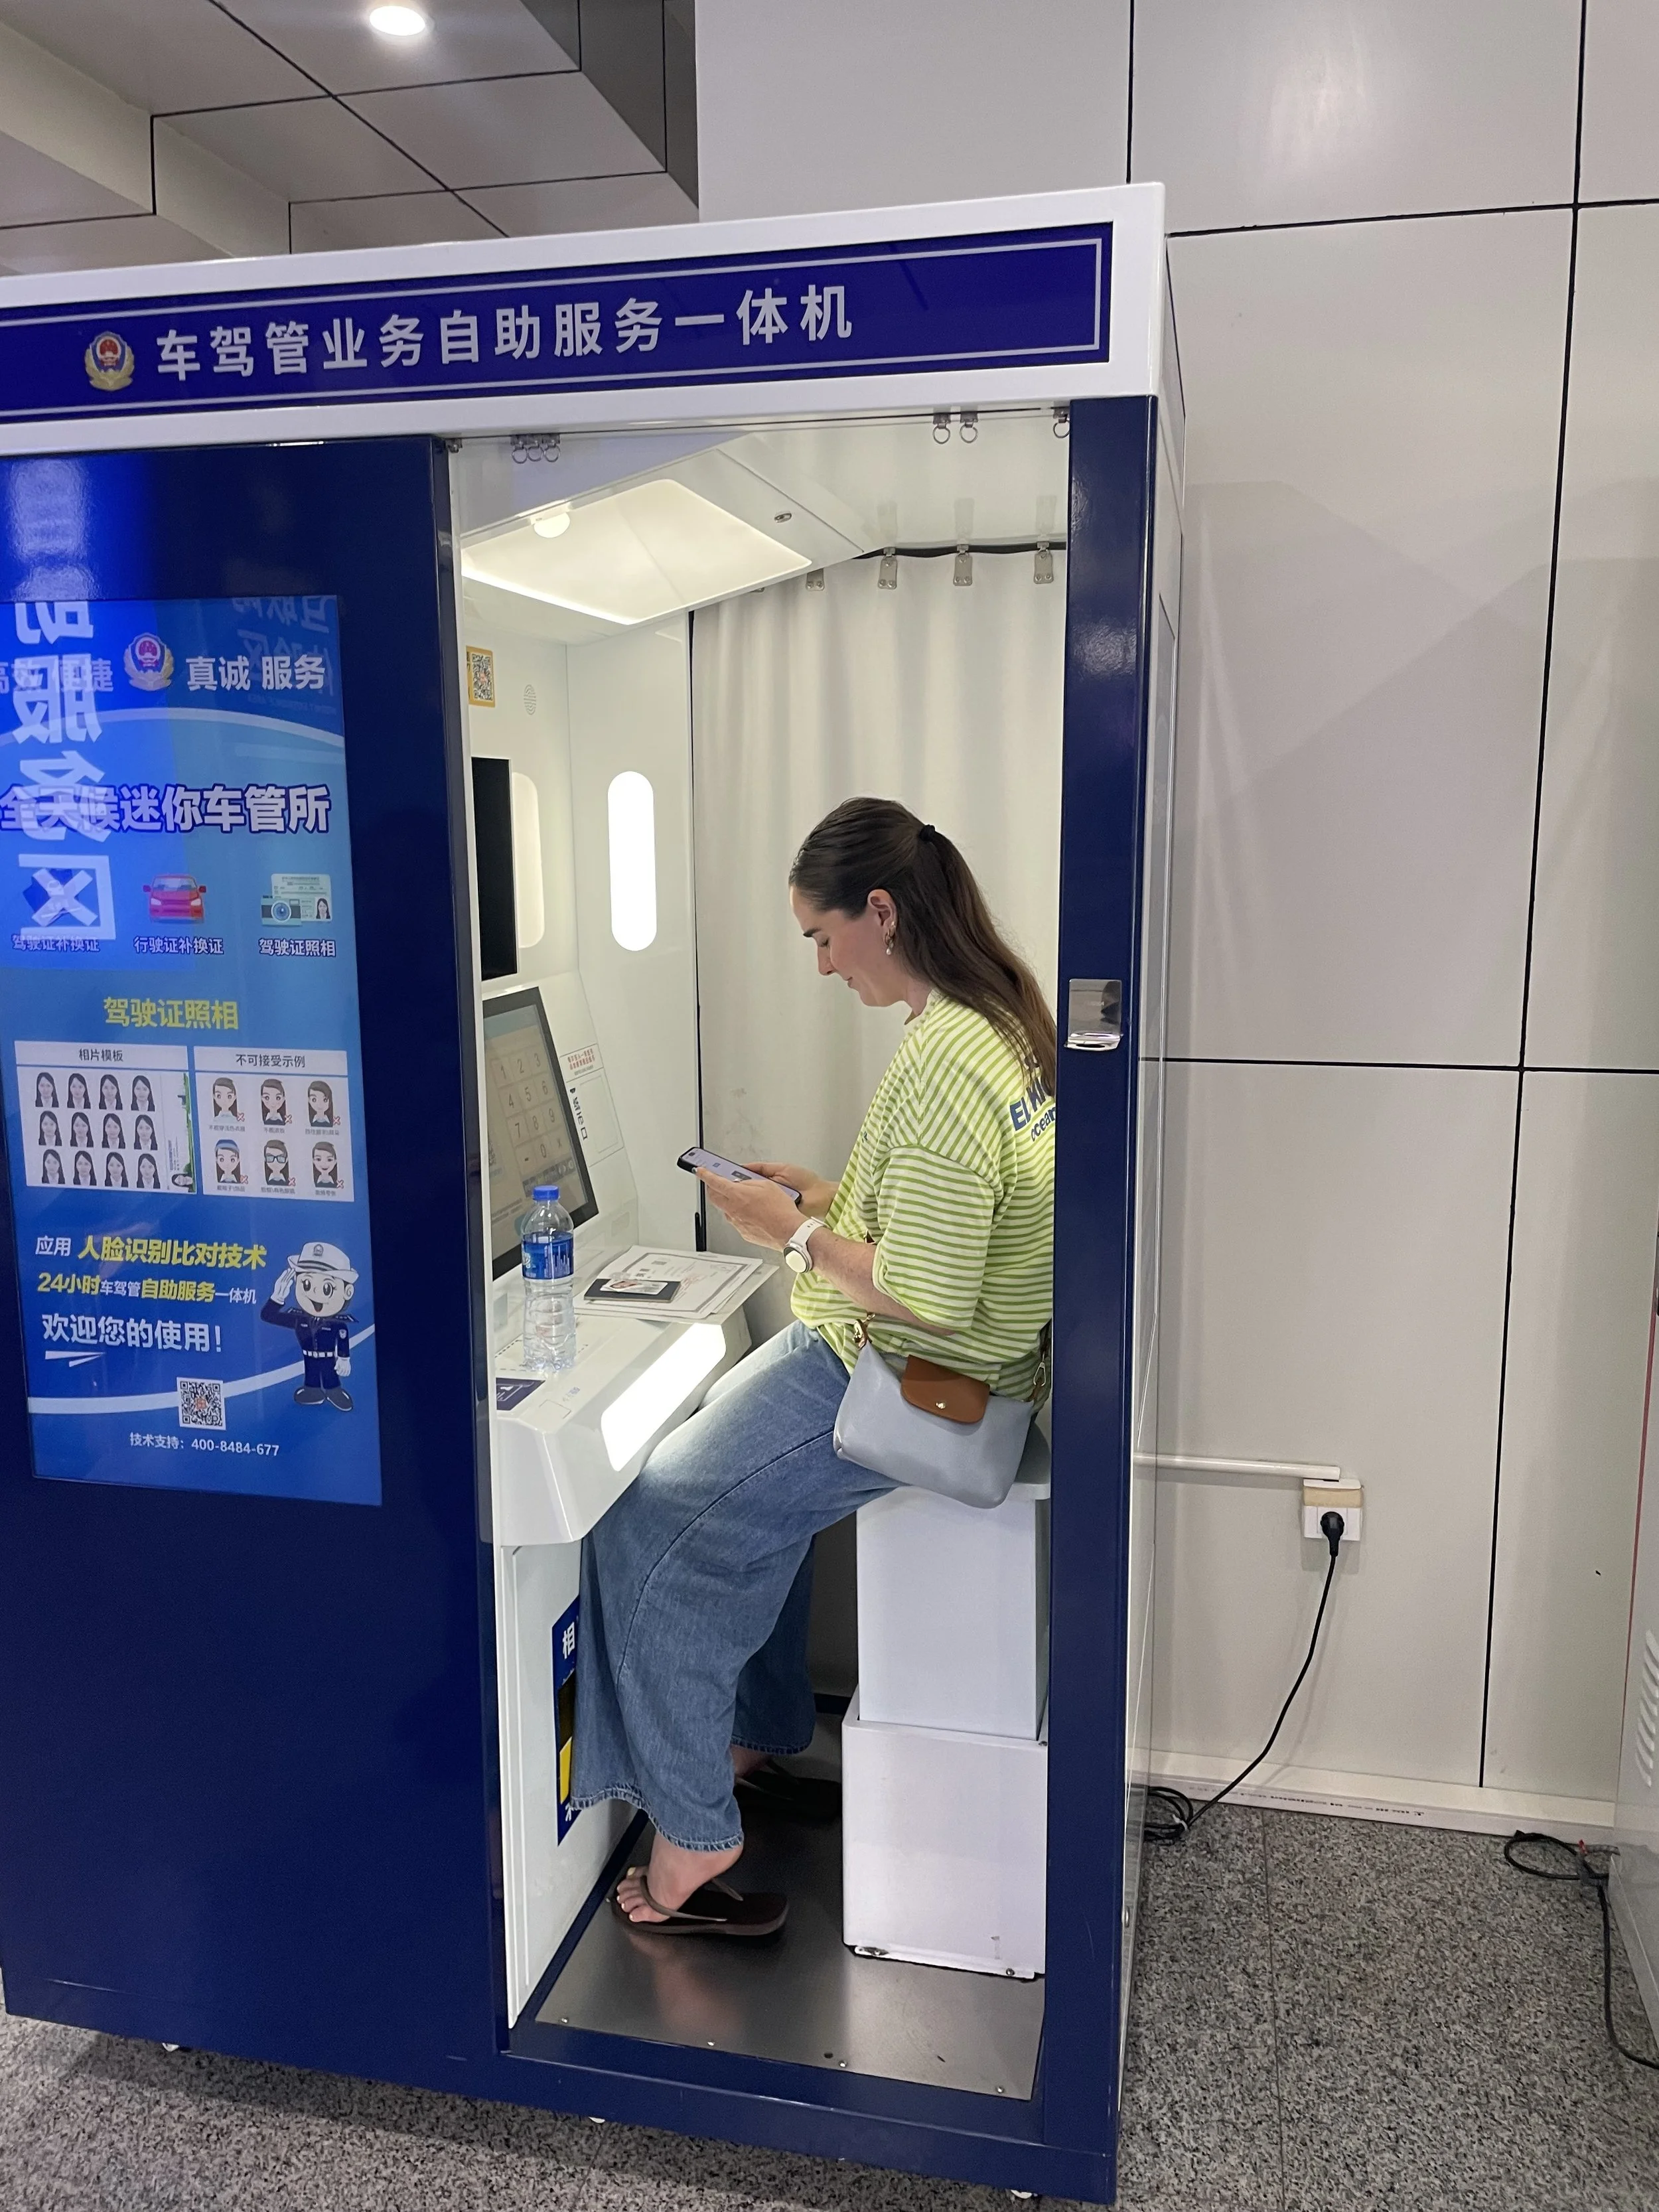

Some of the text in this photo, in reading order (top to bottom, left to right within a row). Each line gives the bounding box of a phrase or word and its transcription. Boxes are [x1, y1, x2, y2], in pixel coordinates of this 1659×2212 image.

[156, 284, 852, 382] 车驾管业务自助服务一体机
[186, 656, 251, 691] 真诚
[261, 654, 325, 690] 服务
[134, 936, 225, 955] 行驶证补换证
[259, 938, 336, 957] 驾驶证照相
[104, 997, 240, 1030] 驾驶证照相
[78, 1047, 124, 1063] 相片模板
[236, 1053, 306, 1069] 不可接受示例
[35, 1235, 267, 1270] 应用 人脸识别比对技术
[36, 1273, 257, 1305] 24小时车驾管自助服务一体机
[42, 1313, 222, 1353] 欢迎您的使用！
